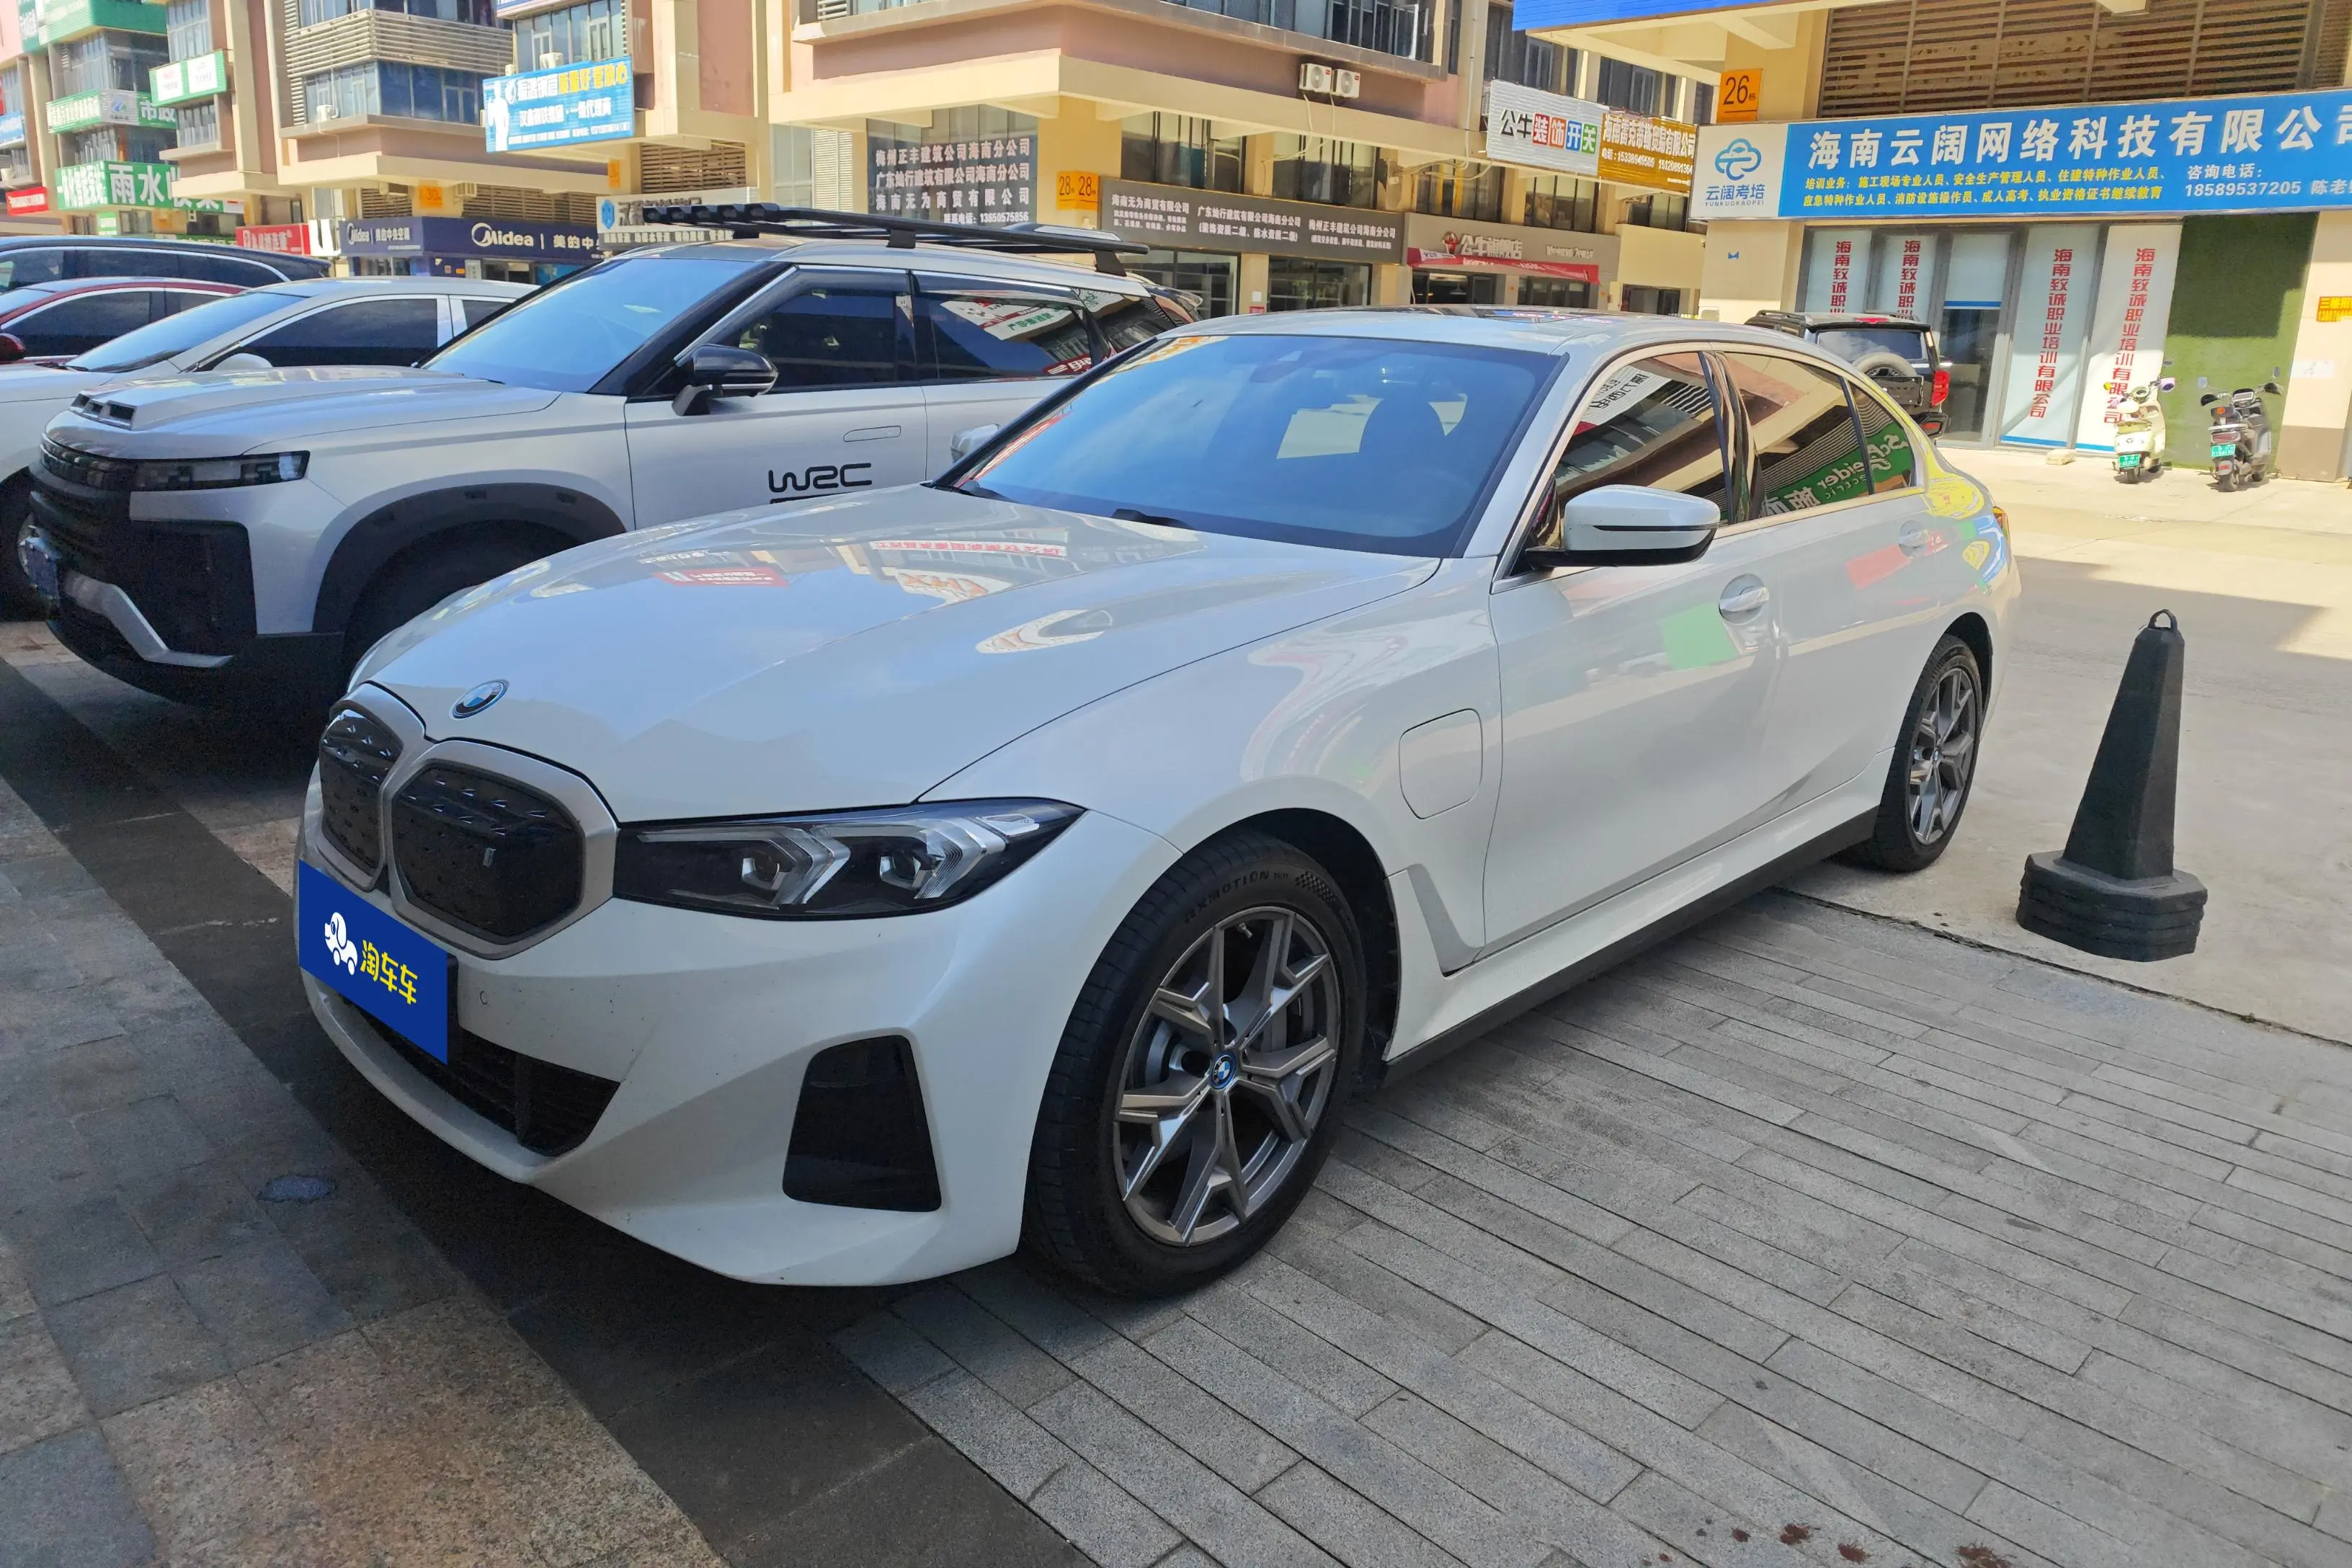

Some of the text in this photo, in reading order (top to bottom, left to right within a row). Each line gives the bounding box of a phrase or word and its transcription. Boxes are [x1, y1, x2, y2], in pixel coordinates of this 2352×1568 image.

[1500, 109, 1597, 152] 公牛装饰开关
[876, 187, 1030, 211] 海南无为商贸有限公司
[1706, 183, 1765, 200] 云阔考培
[2185, 179, 2352, 197] 18589537205 陈老
[471, 222, 534, 248] Midea
[553, 234, 600, 251] 美的中
[2029, 248, 2073, 419] 海南致诚职业培训有限公司
[768, 463, 873, 493] WRC
